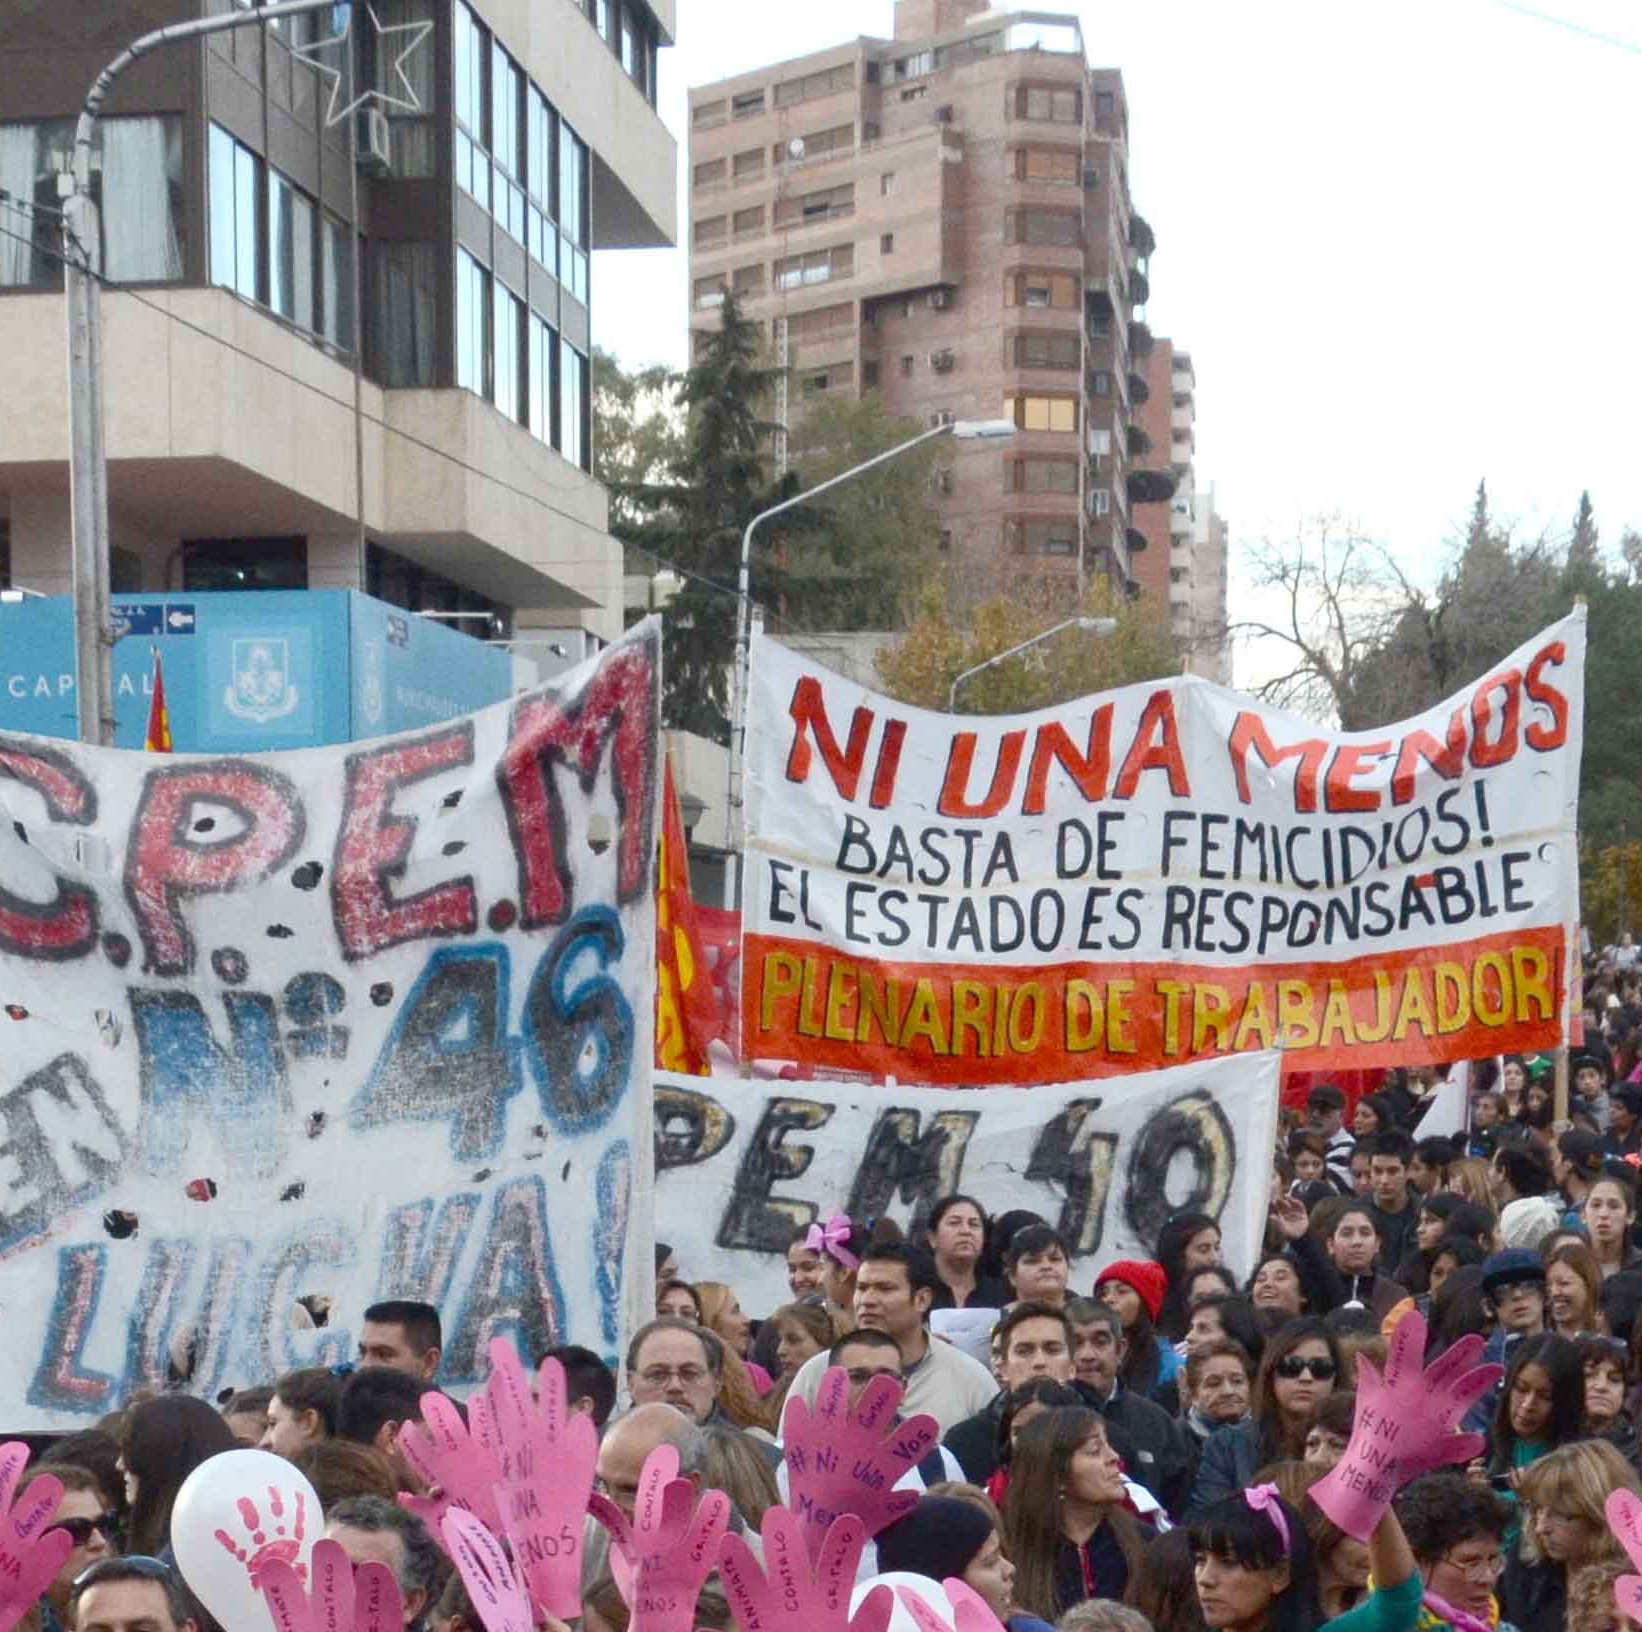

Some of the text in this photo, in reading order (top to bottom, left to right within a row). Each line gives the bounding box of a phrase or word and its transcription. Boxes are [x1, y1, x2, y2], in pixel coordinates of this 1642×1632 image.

[8, 671, 154, 699] CAPAL
[786, 640, 1570, 819] NI UNA MENOS
[837, 778, 1495, 891] BASTA DE FEMICIDIOS!
[768, 851, 1536, 955] EL ESTADO ES RESPONSABLE
[351, 900, 639, 1162] 46
[760, 945, 1555, 1058] PLENARIO DE TRABAJADOR
[724, 1556, 760, 1631] ANIMATE
[773, 1530, 799, 1613] CONTALO
